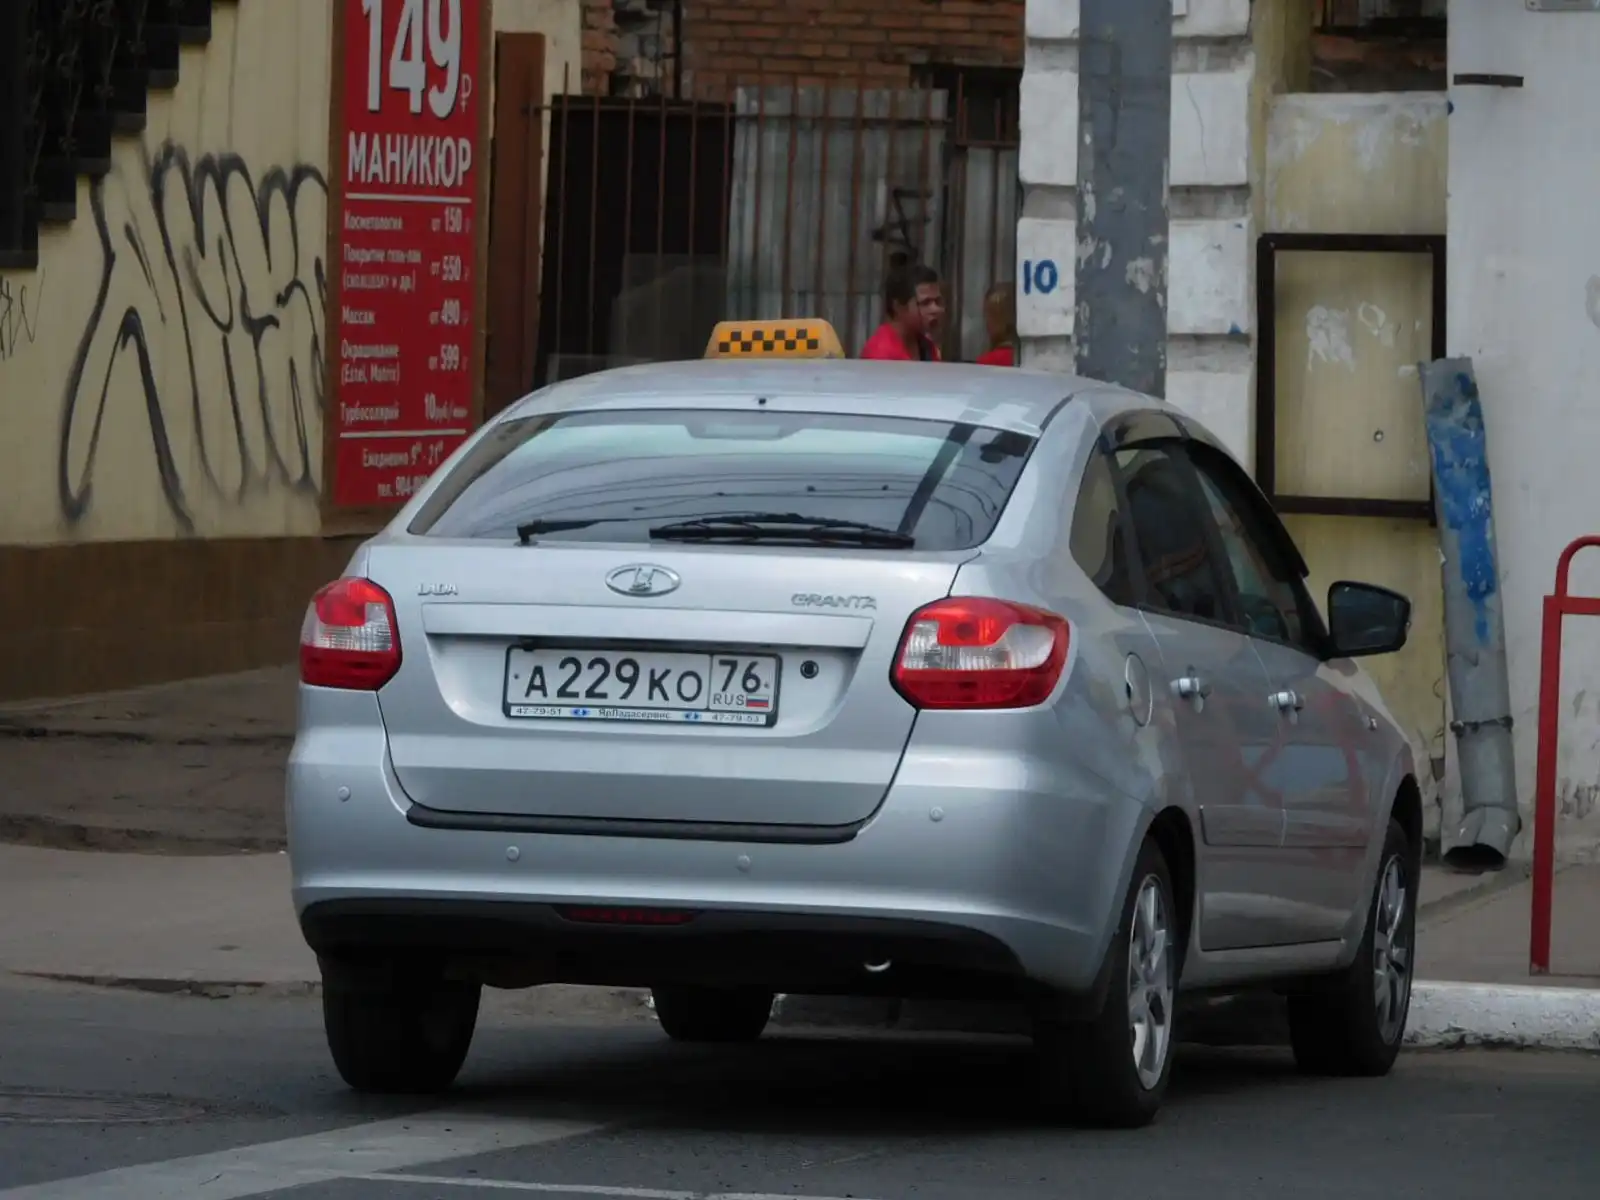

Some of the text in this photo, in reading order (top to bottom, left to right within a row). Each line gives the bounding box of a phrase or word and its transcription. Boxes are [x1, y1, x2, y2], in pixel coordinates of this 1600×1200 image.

[362, 0, 461, 118] 149
[348, 130, 472, 188] МАНИКЮР
[344, 210, 403, 231] Косметология
[444, 206, 463, 233] 150
[442, 255, 461, 281] 550
[1023, 259, 1058, 296] 10
[342, 305, 375, 324] Массаж
[441, 298, 461, 325] 490
[341, 338, 399, 363] Окрашивание
[440, 343, 460, 371] 599
[340, 400, 400, 425] Турбосолярий
[363, 448, 409, 468] Ежедневно
[417, 582, 459, 597] LADA
[791, 592, 878, 611] GRANTA
[718, 659, 761, 694] 76
[712, 692, 746, 706] RUS
